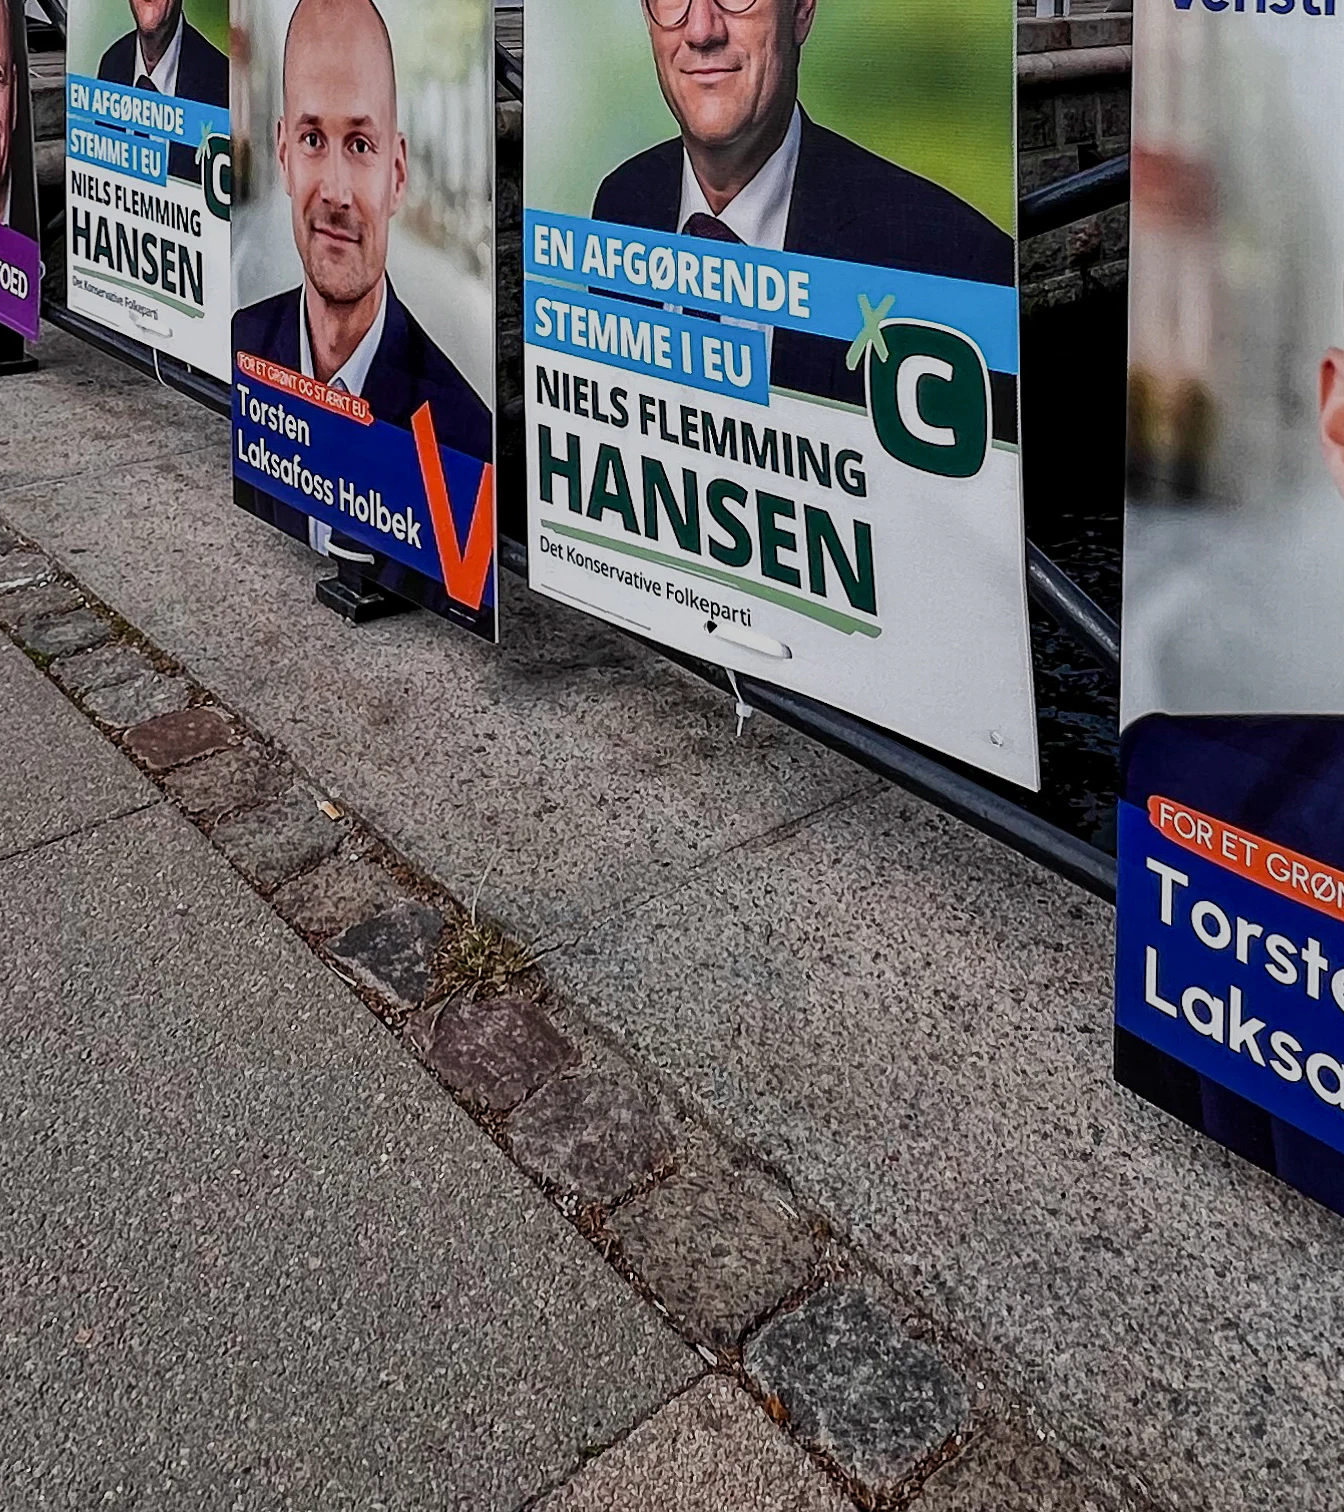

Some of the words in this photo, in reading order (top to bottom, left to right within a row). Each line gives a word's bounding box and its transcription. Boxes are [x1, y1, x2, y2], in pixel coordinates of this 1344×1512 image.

[70, 83, 90, 111] EN
[92, 88, 185, 136] AFGØRENDE
[70, 127, 130, 170] STEMME
[132, 145, 138, 171] I
[141, 147, 161, 177] EU
[71, 169, 111, 207] NIELS
[115, 187, 202, 238] FLEMMING
[213, 152, 231, 205] C
[72, 206, 204, 306] HANSEN
[533, 223, 574, 271] EN
[581, 233, 811, 319] AFGØRENDE
[240, 353, 255, 373] FOR
[256, 361, 266, 377] ET
[299, 380, 313, 397] OG
[314, 385, 351, 412] STÆRKT
[352, 401, 366, 418] EU
[534, 297, 672, 369] STEMME
[681, 330, 692, 375] I
[703, 336, 752, 388] EU
[237, 383, 310, 446] Torsten
[536, 365, 629, 428] NIELS
[639, 393, 868, 498] FLEMMING
[896, 353, 957, 447] C
[238, 428, 334, 506] Laksafoss
[339, 477, 422, 550] Holbek
[539, 424, 878, 617] HANSEN
[539, 534, 564, 561] Det
[566, 540, 662, 597] Konservative
[666, 581, 752, 627] Folkeparti
[1158, 802, 1214, 849] FOR
[1222, 831, 1259, 867] ET
